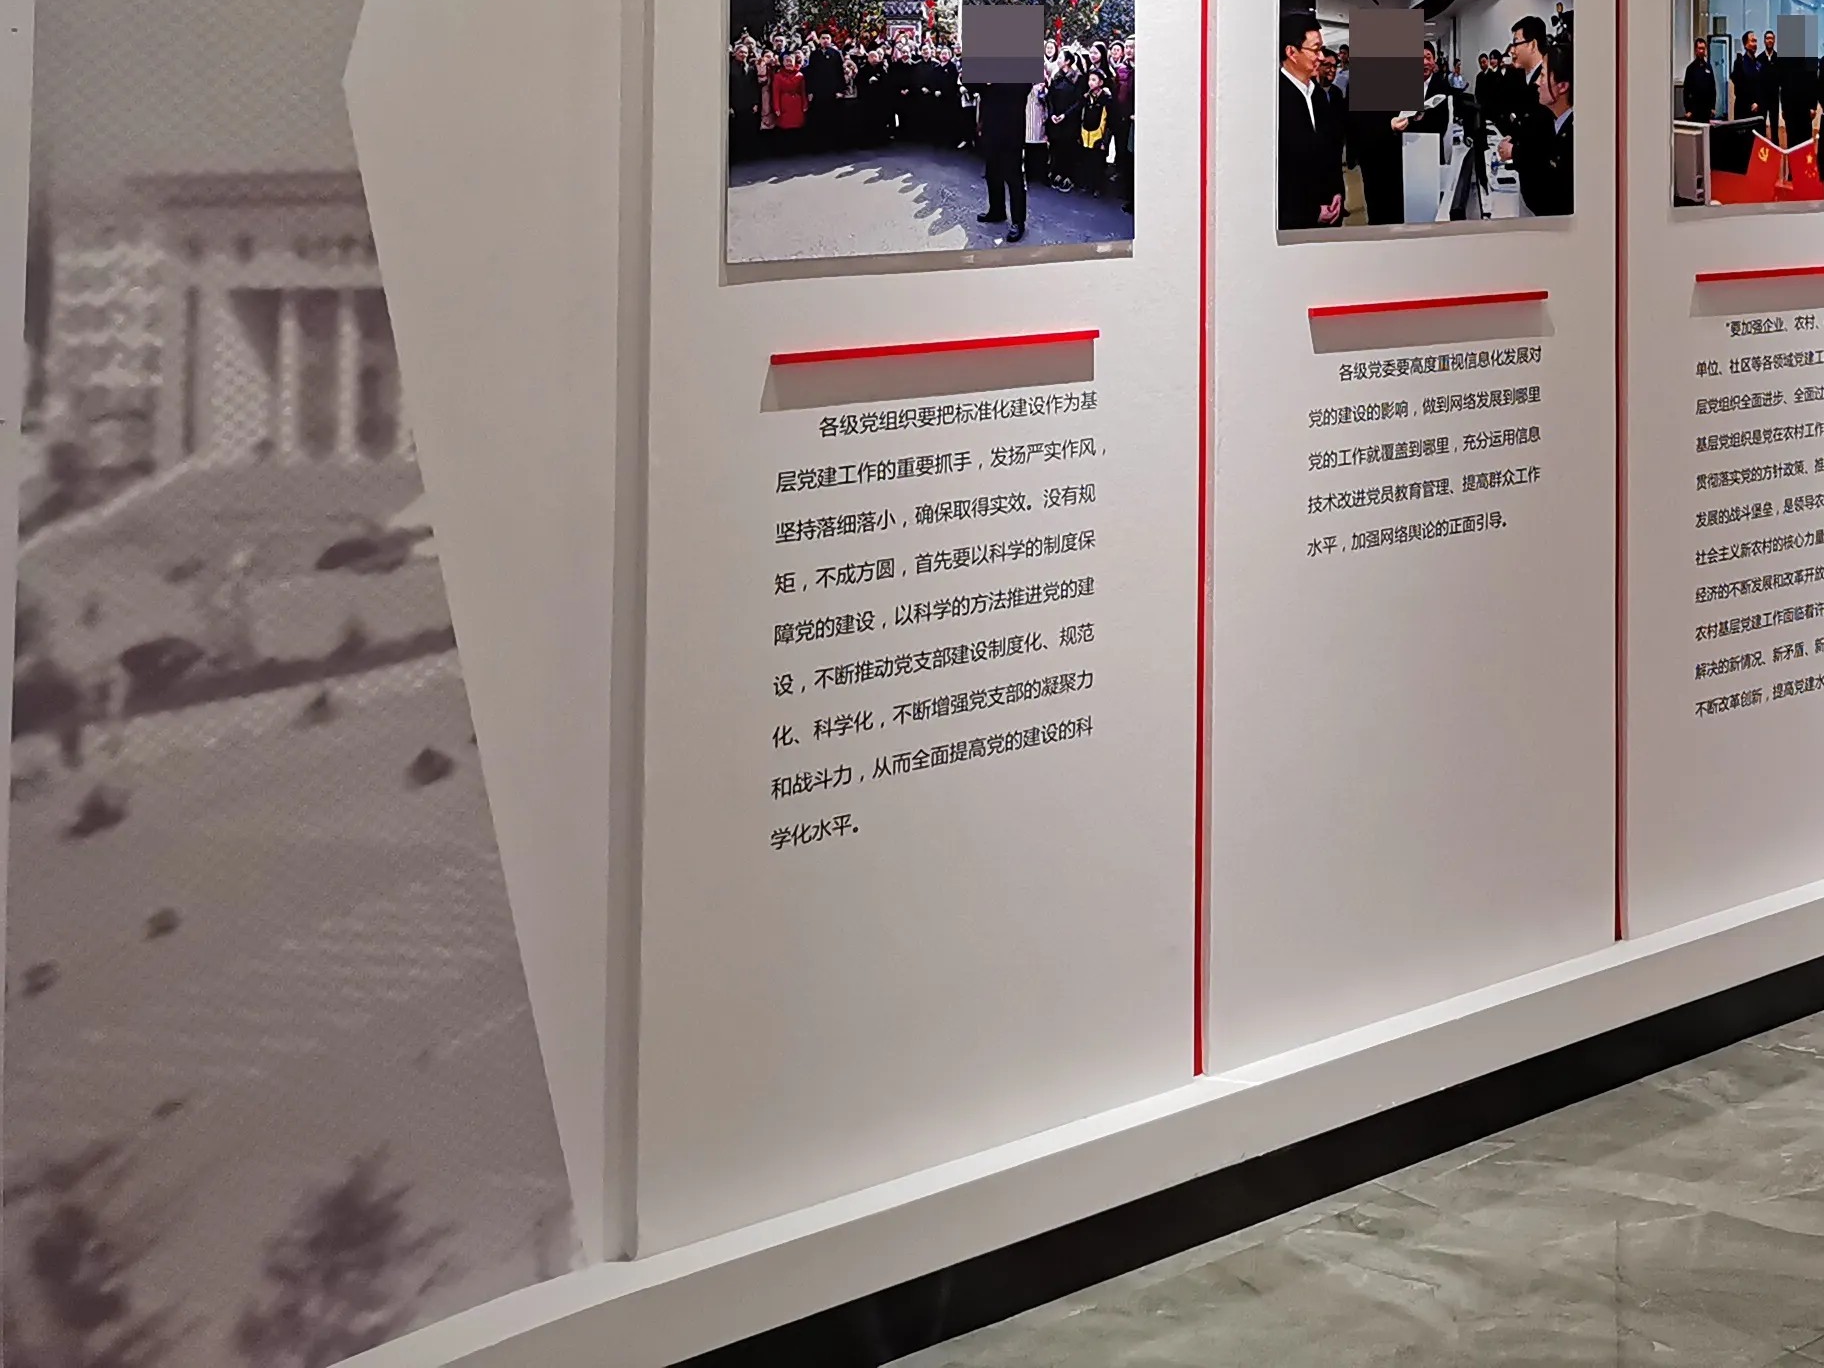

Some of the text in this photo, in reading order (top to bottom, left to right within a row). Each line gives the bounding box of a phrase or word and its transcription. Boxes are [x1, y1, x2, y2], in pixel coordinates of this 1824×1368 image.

[1339, 345, 1541, 381] 各级党委要高度重视信息化发展对
[818, 391, 1098, 437] 各级党组织要把标准化建设作为基
[1308, 386, 1541, 427] 党的建设的影响，做到网络发展到哪里
[776, 438, 1107, 494] 层党建工作的重要抓手，发扬严实作风，
[1308, 426, 1541, 471] 党的工作就覆盖到哪里，充分运用信息
[775, 483, 1096, 544] 坚持落细落小，确保取得实效。没有规
[1308, 466, 1541, 515] 技术改进党员教育管理、提高群众工作
[1307, 512, 1507, 557] 水平，加强网络舆论的正面引导。
[774, 530, 1096, 595] 矩，不成方圆，首先要以科学的制度保
[774, 576, 1095, 646] 障党的建设，以科学的方法推进党的建
[773, 623, 1095, 697] 设，不断推动党支部建设制度化、规范
[772, 670, 1094, 747] 化、科学化，不断增强党支部的凝聚力
[771, 715, 1093, 799] 和战斗力，从而全面提高党的建设的科
[771, 814, 860, 851] 学化水平。
